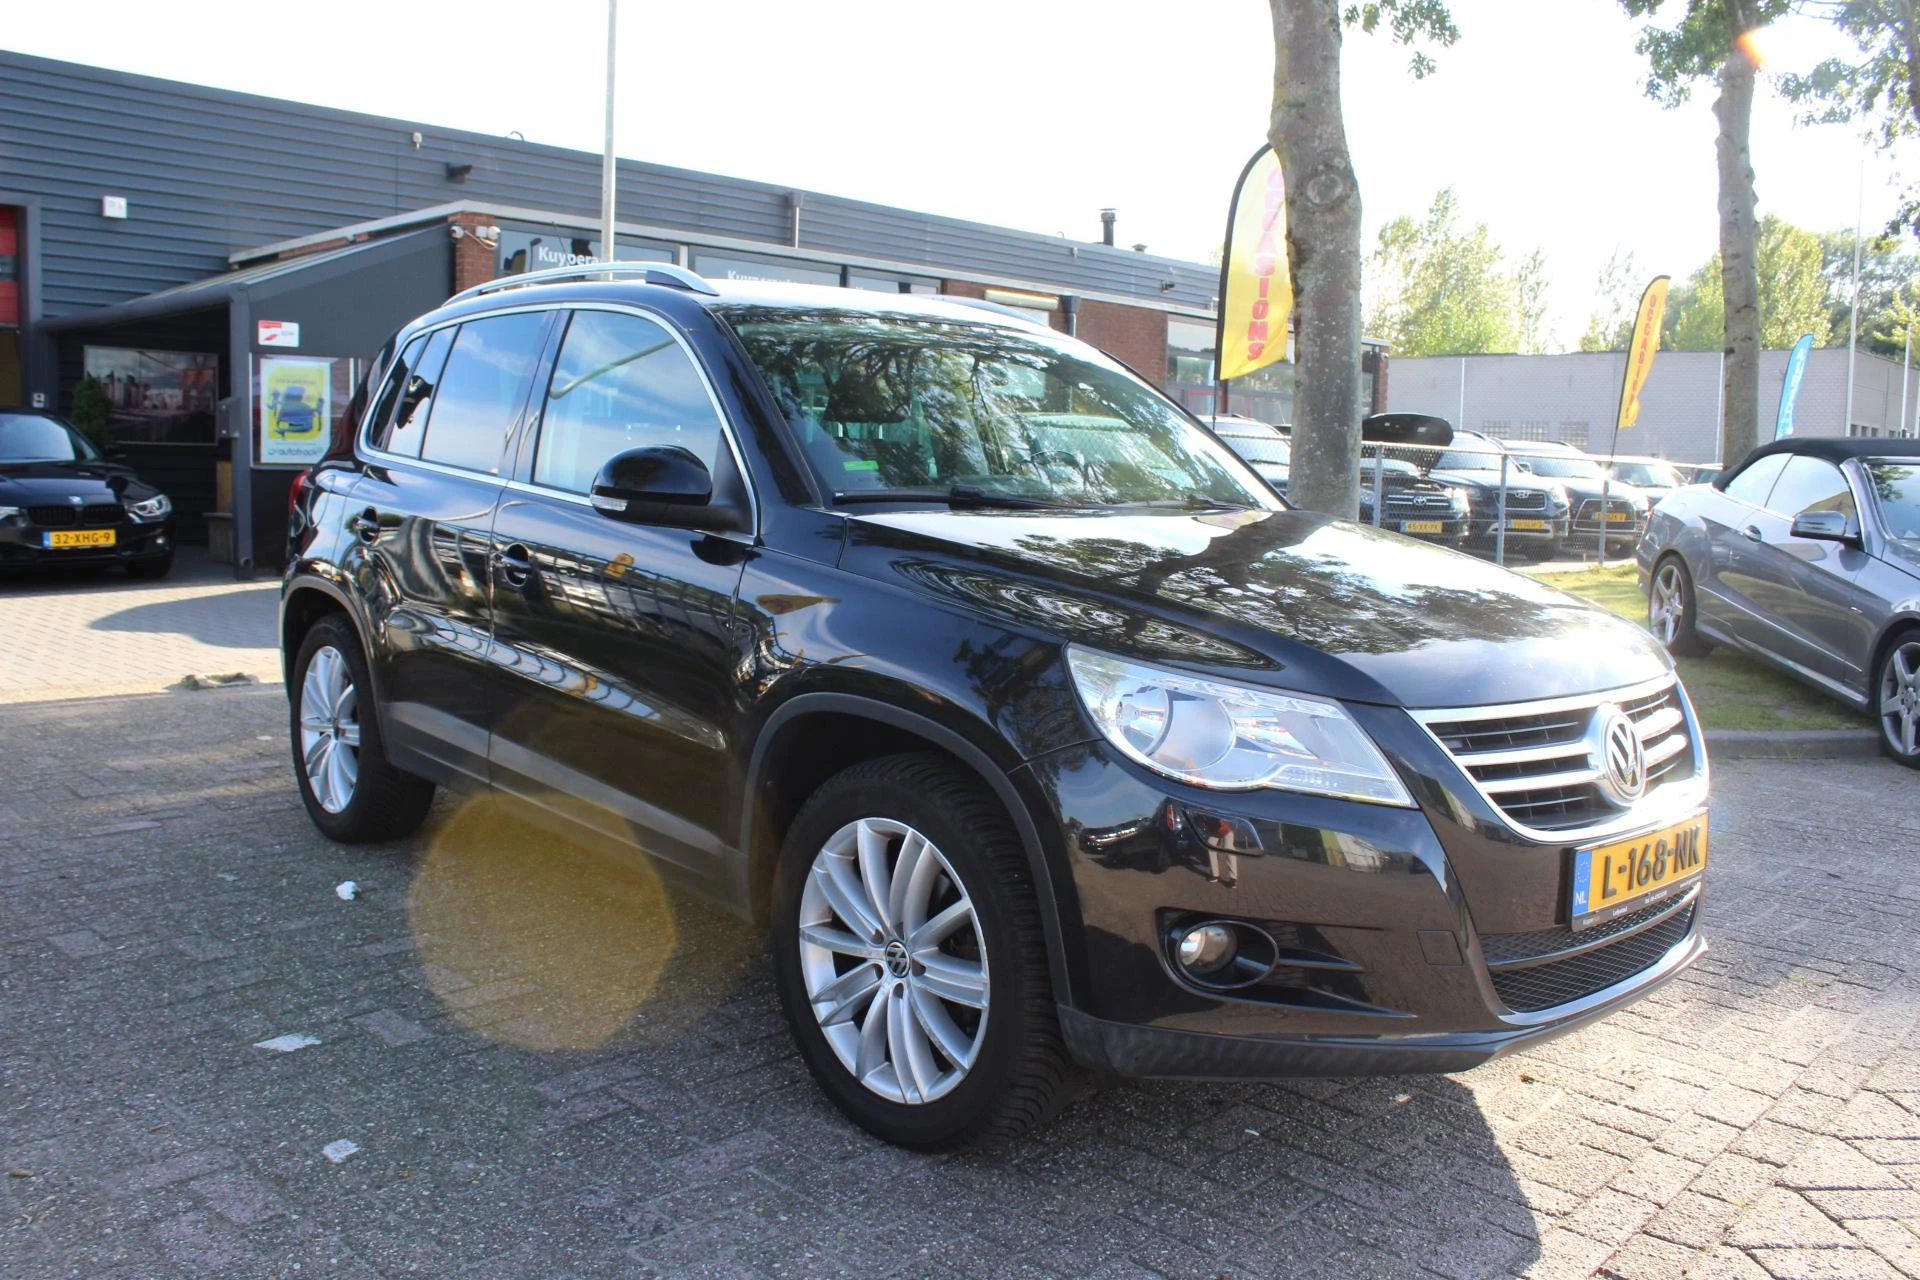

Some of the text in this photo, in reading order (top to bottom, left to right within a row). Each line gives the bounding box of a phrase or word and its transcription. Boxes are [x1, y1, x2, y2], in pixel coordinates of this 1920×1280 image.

[538, 247, 622, 268] Kuypera
[1247, 166, 1285, 362] OCCASIONS
[54, 532, 111, 545] 32-XHG-9
[1601, 824, 1701, 900] L-168-NK
[1575, 891, 1587, 905] NL
